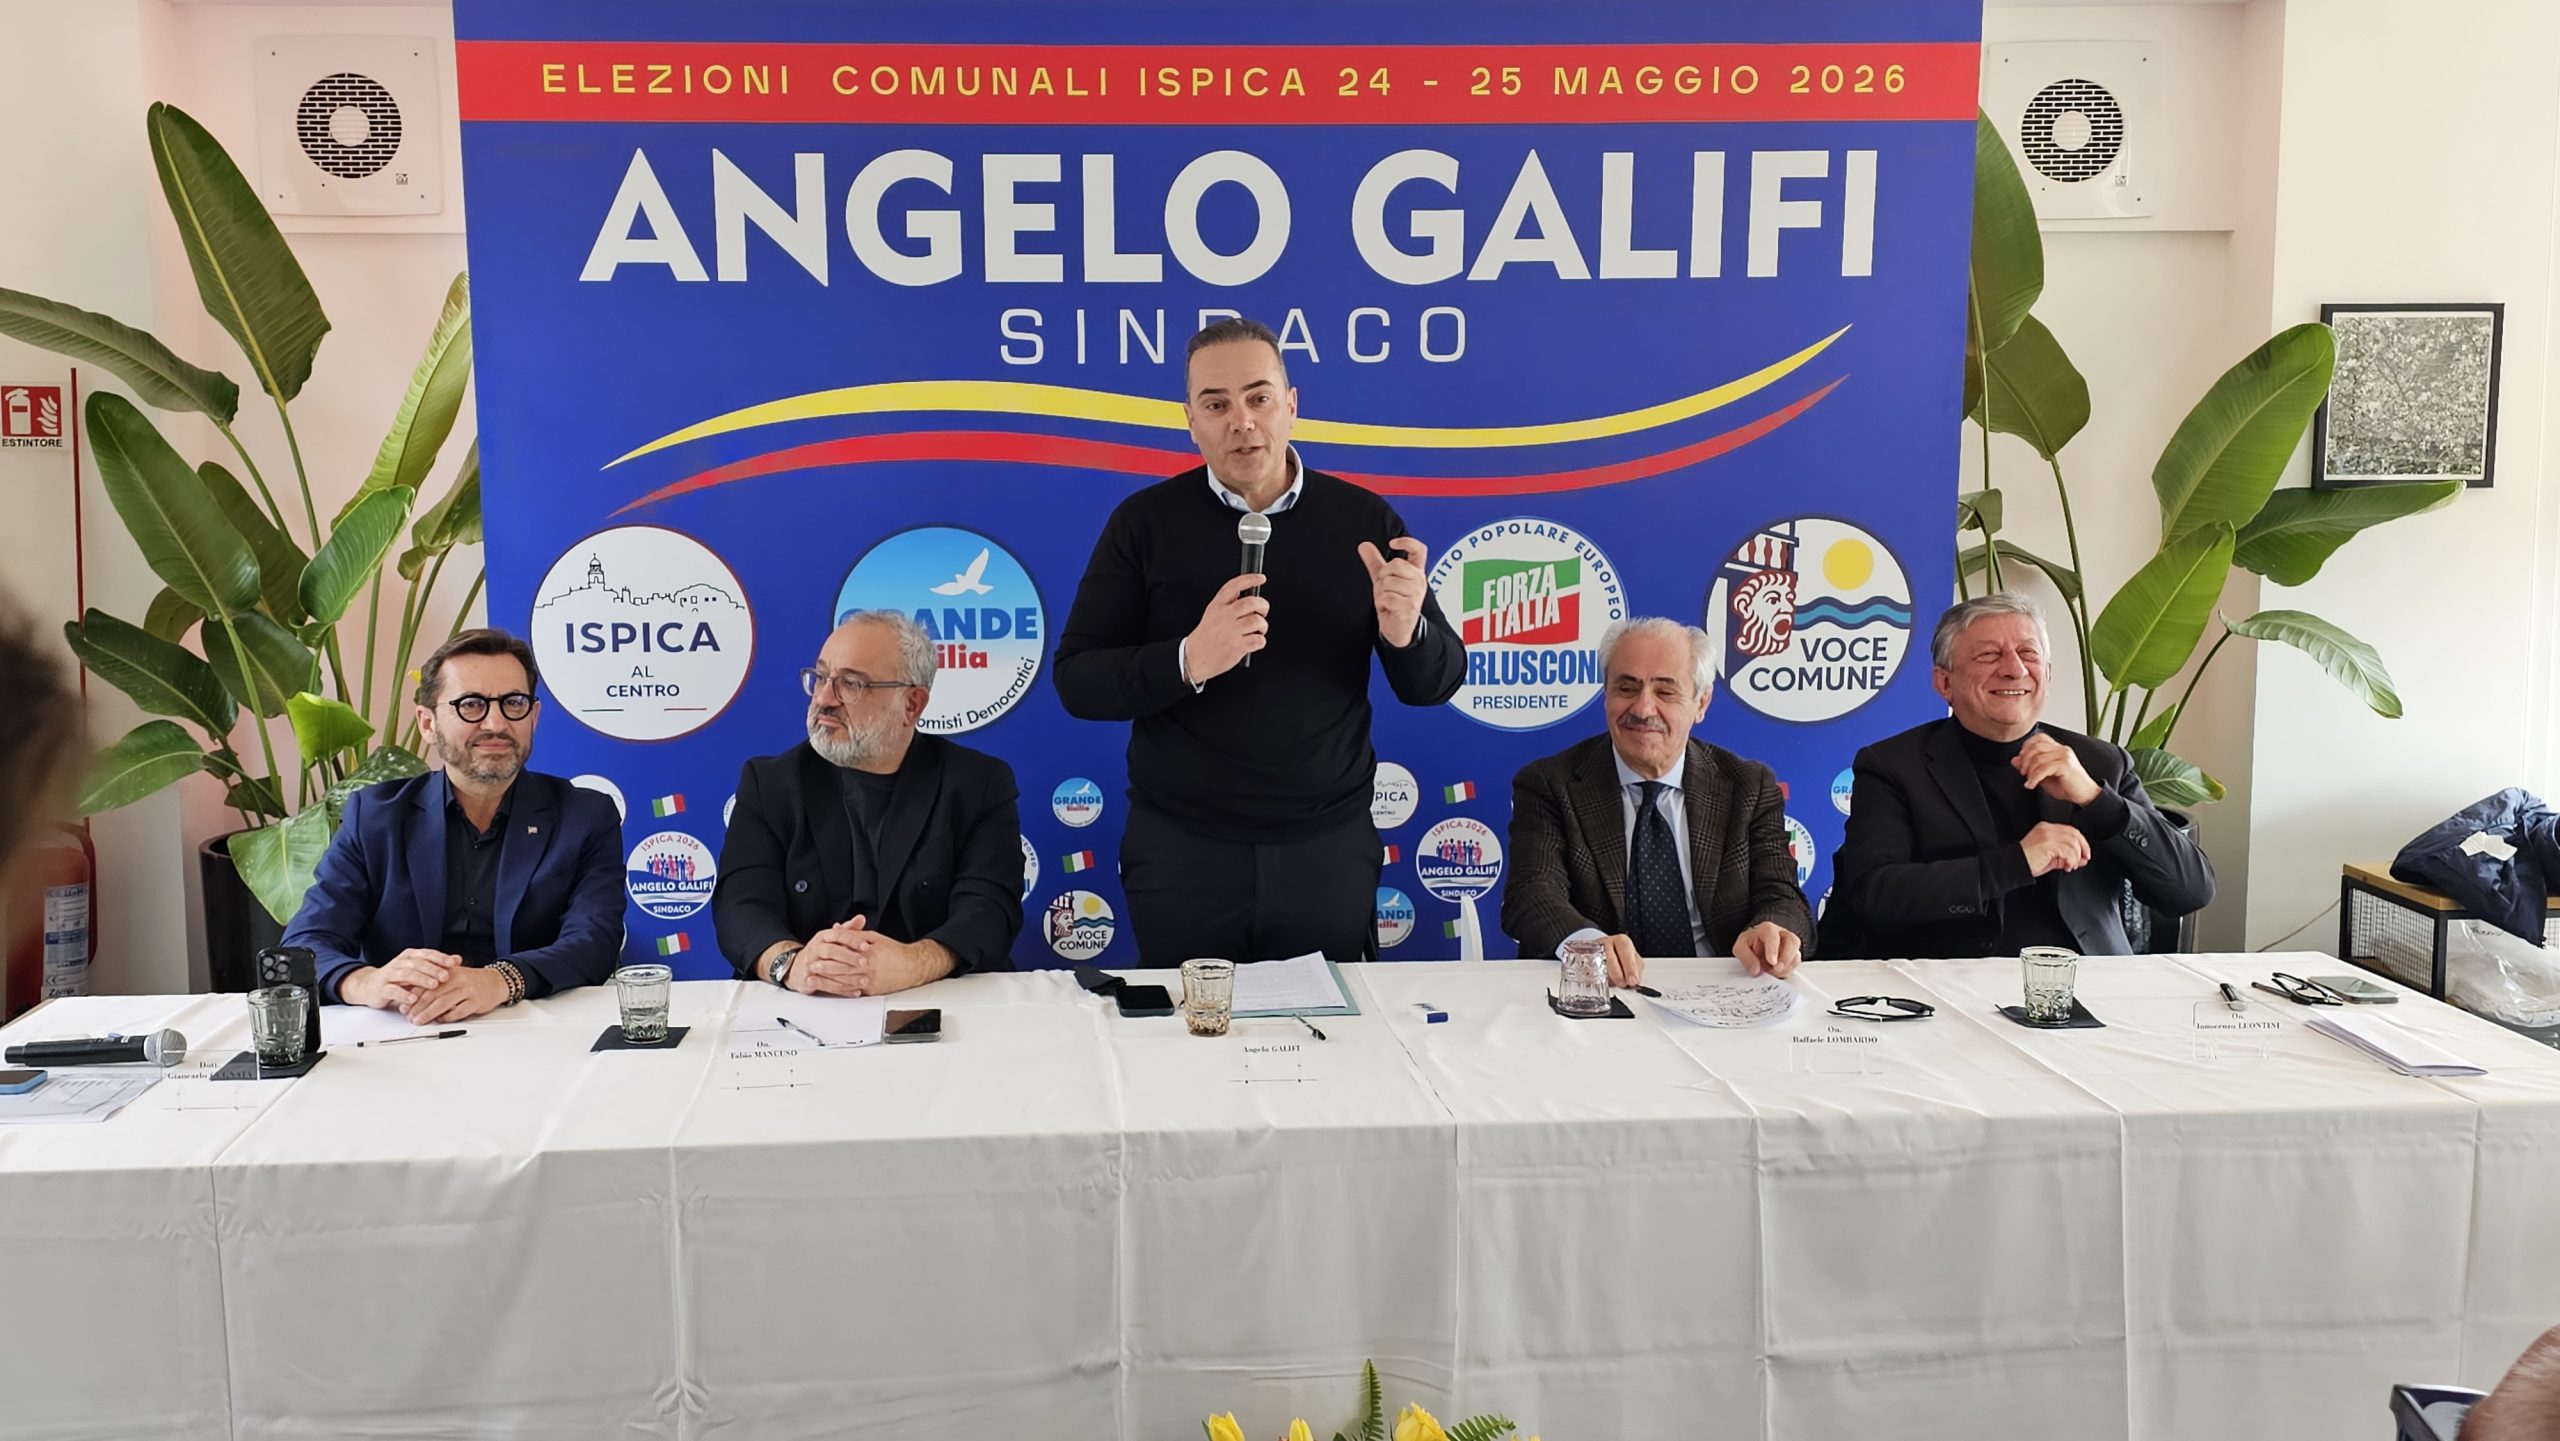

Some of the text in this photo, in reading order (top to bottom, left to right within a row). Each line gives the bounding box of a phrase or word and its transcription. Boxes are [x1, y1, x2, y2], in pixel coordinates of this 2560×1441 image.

[542, 63, 789, 95] ELEZIONI
[832, 65, 1108, 96] COMUNALI
[1139, 67, 1306, 97] ISPICA
[1338, 67, 1391, 97] 24
[1470, 67, 1522, 96] 25
[1553, 65, 1760, 95] MAGGIO
[1789, 64, 1905, 94] 2026
[578, 147, 1878, 287] ANGELO GALIFI
[2, 438, 63, 448] ESTINTORE
[1430, 522, 1622, 620] TITO POPOLARE EUROPEO
[1482, 562, 1557, 612] FORZA
[1482, 592, 1561, 642] ITALIA
[565, 621, 721, 654] ISPICA
[936, 643, 988, 669] ilia
[1799, 636, 1888, 663] VOCE
[631, 665, 655, 679] AL
[1465, 649, 1604, 687] RLUSCON
[1749, 665, 1886, 692] COMUNE
[606, 683, 681, 698] CENTRO
[917, 656, 1036, 731] omisti Democratici
[1472, 694, 1569, 710] PRESIDENTE
[1053, 795, 1102, 805] GRANDE
[1375, 791, 1409, 802] PICA
[1431, 820, 1488, 838] ISPICA 2026
[641, 834, 700, 852] ISPICA 2026
[1421, 865, 1499, 876] ANGELO GALIFI
[631, 880, 713, 892] ANGELO GALIFI
[652, 904, 692, 914] SINDACO
[1377, 909, 1414, 920] ANDE
[1076, 930, 1108, 940] VOCE
[1058, 940, 1108, 951] COMUNE
[1827, 1035, 1879, 1044] LOMBARDO
[754, 1049, 799, 1059] MANCUSO
[1271, 1044, 1300, 1053] GALIFI
[167, 1072, 208, 1080] Giancarlo
